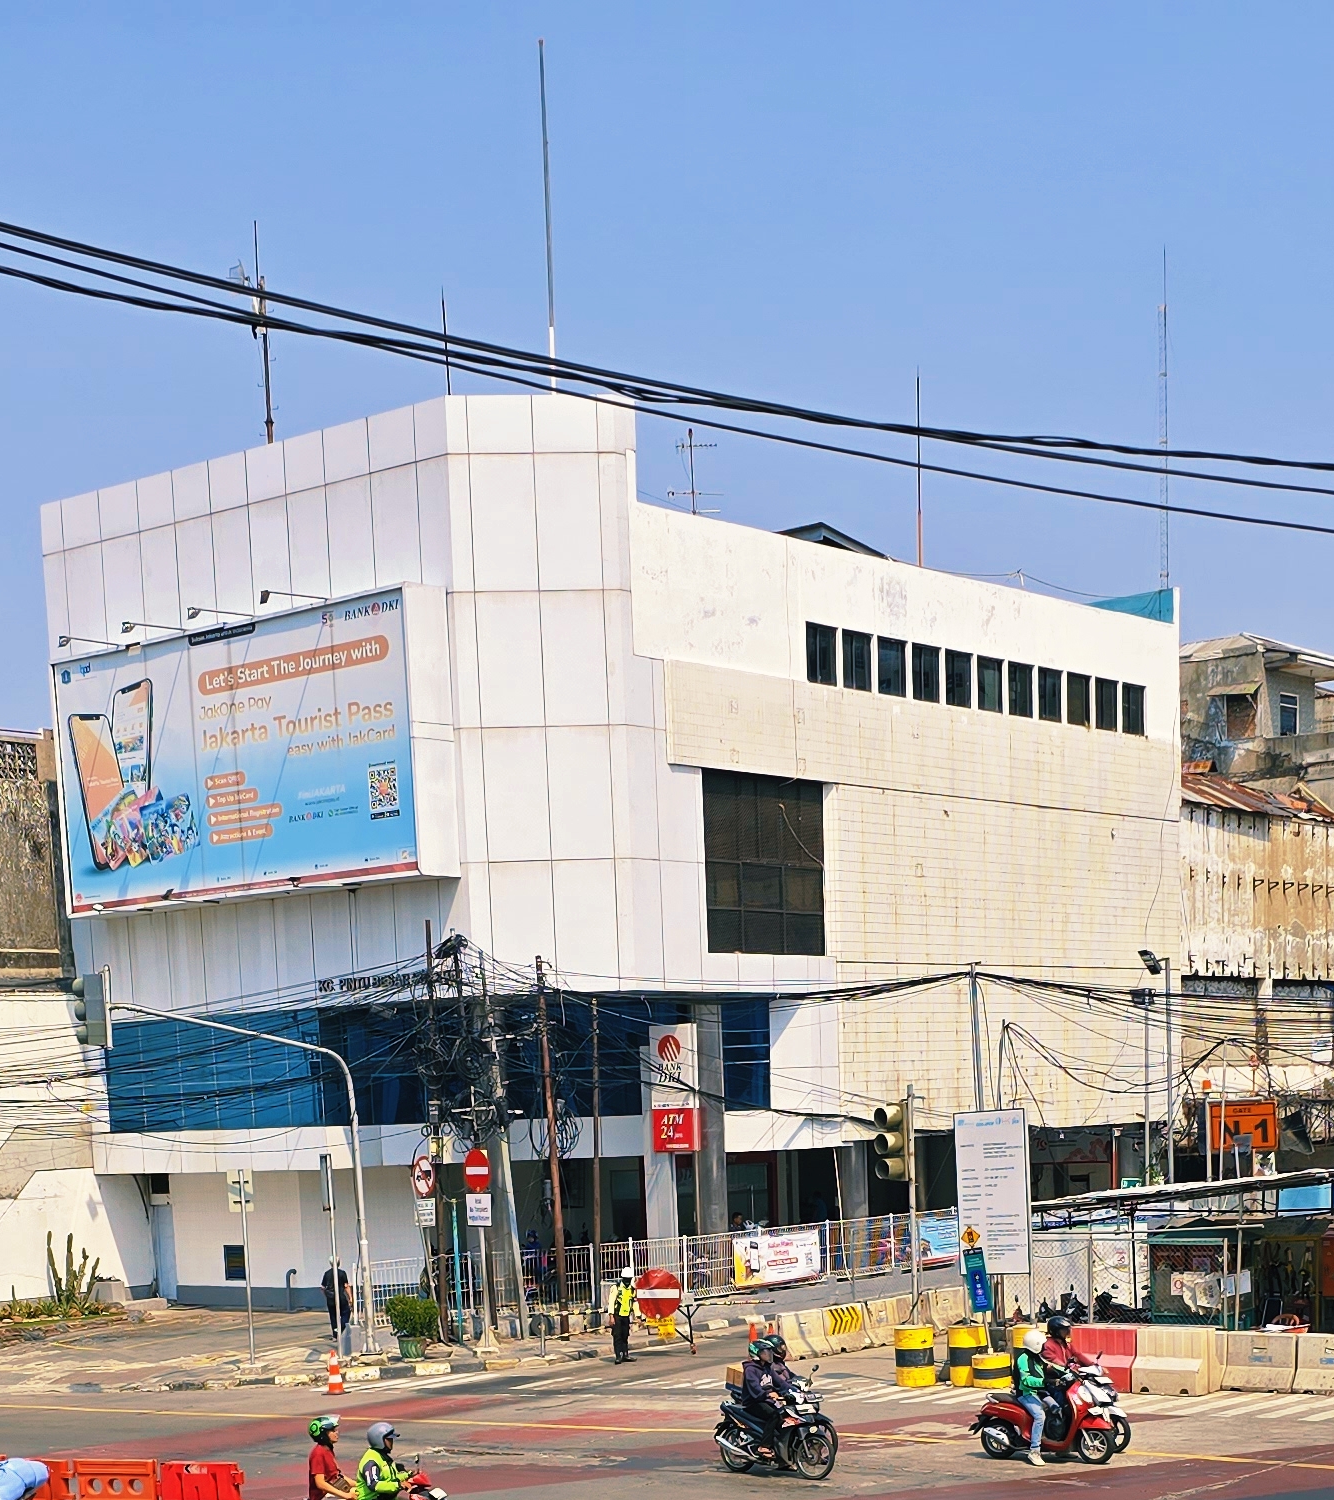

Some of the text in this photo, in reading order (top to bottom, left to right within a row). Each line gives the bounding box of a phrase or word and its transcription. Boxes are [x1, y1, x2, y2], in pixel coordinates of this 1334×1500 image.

[344, 599, 400, 621] BANK DKI
[206, 641, 380, 690] Let's Start The Journey with
[199, 696, 272, 721] JakOne Pay
[201, 700, 395, 752] Jakarta Tourist Pass
[287, 724, 395, 756] easy with JakCard
[289, 813, 306, 823] BANK
[312, 811, 324, 820] DKI
[658, 1063, 682, 1071] BANK
[658, 1072, 682, 1083] DKI
[661, 1113, 684, 1125] ATM
[660, 1125, 674, 1139] 24
[1219, 1118, 1269, 1145] N-1
